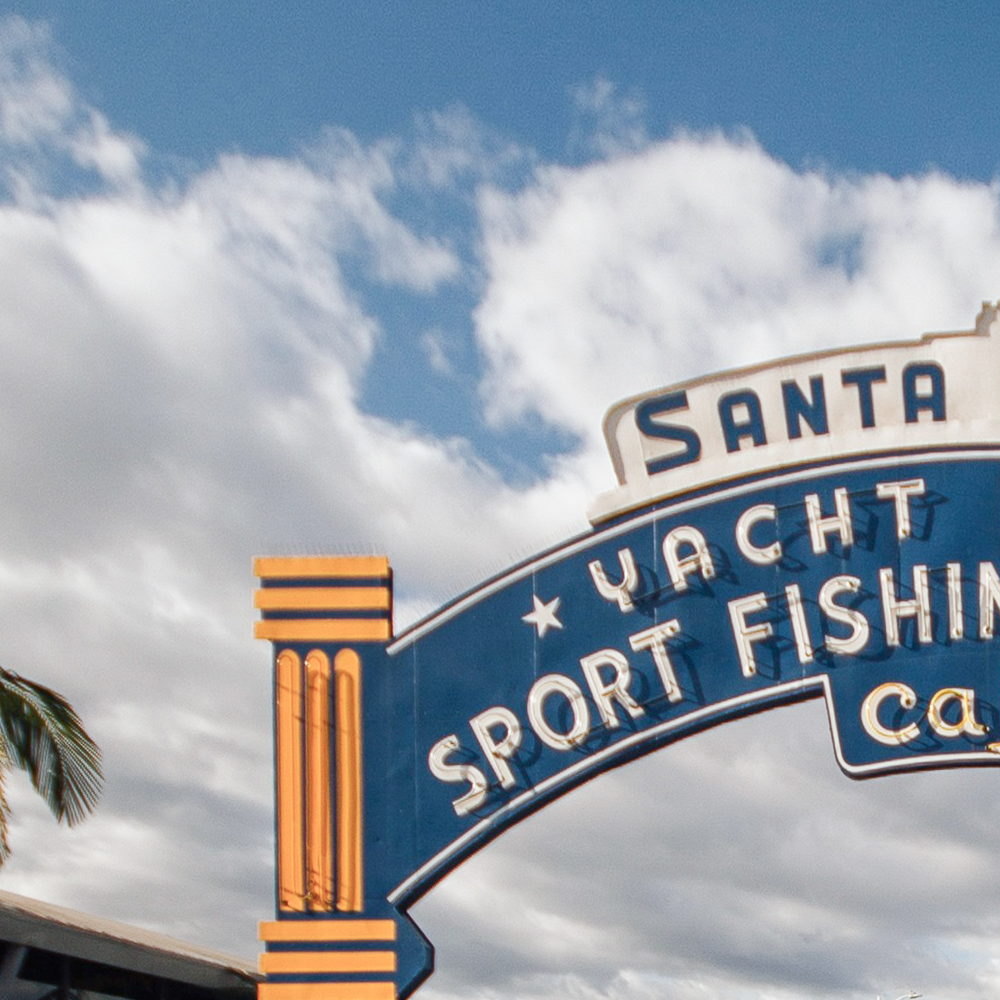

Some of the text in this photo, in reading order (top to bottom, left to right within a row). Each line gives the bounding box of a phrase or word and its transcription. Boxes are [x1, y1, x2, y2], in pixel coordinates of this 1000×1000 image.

[635, 360, 947, 476] SANTA
[588, 478, 926, 613] YACHT
[428, 618, 682, 817] SPORT
